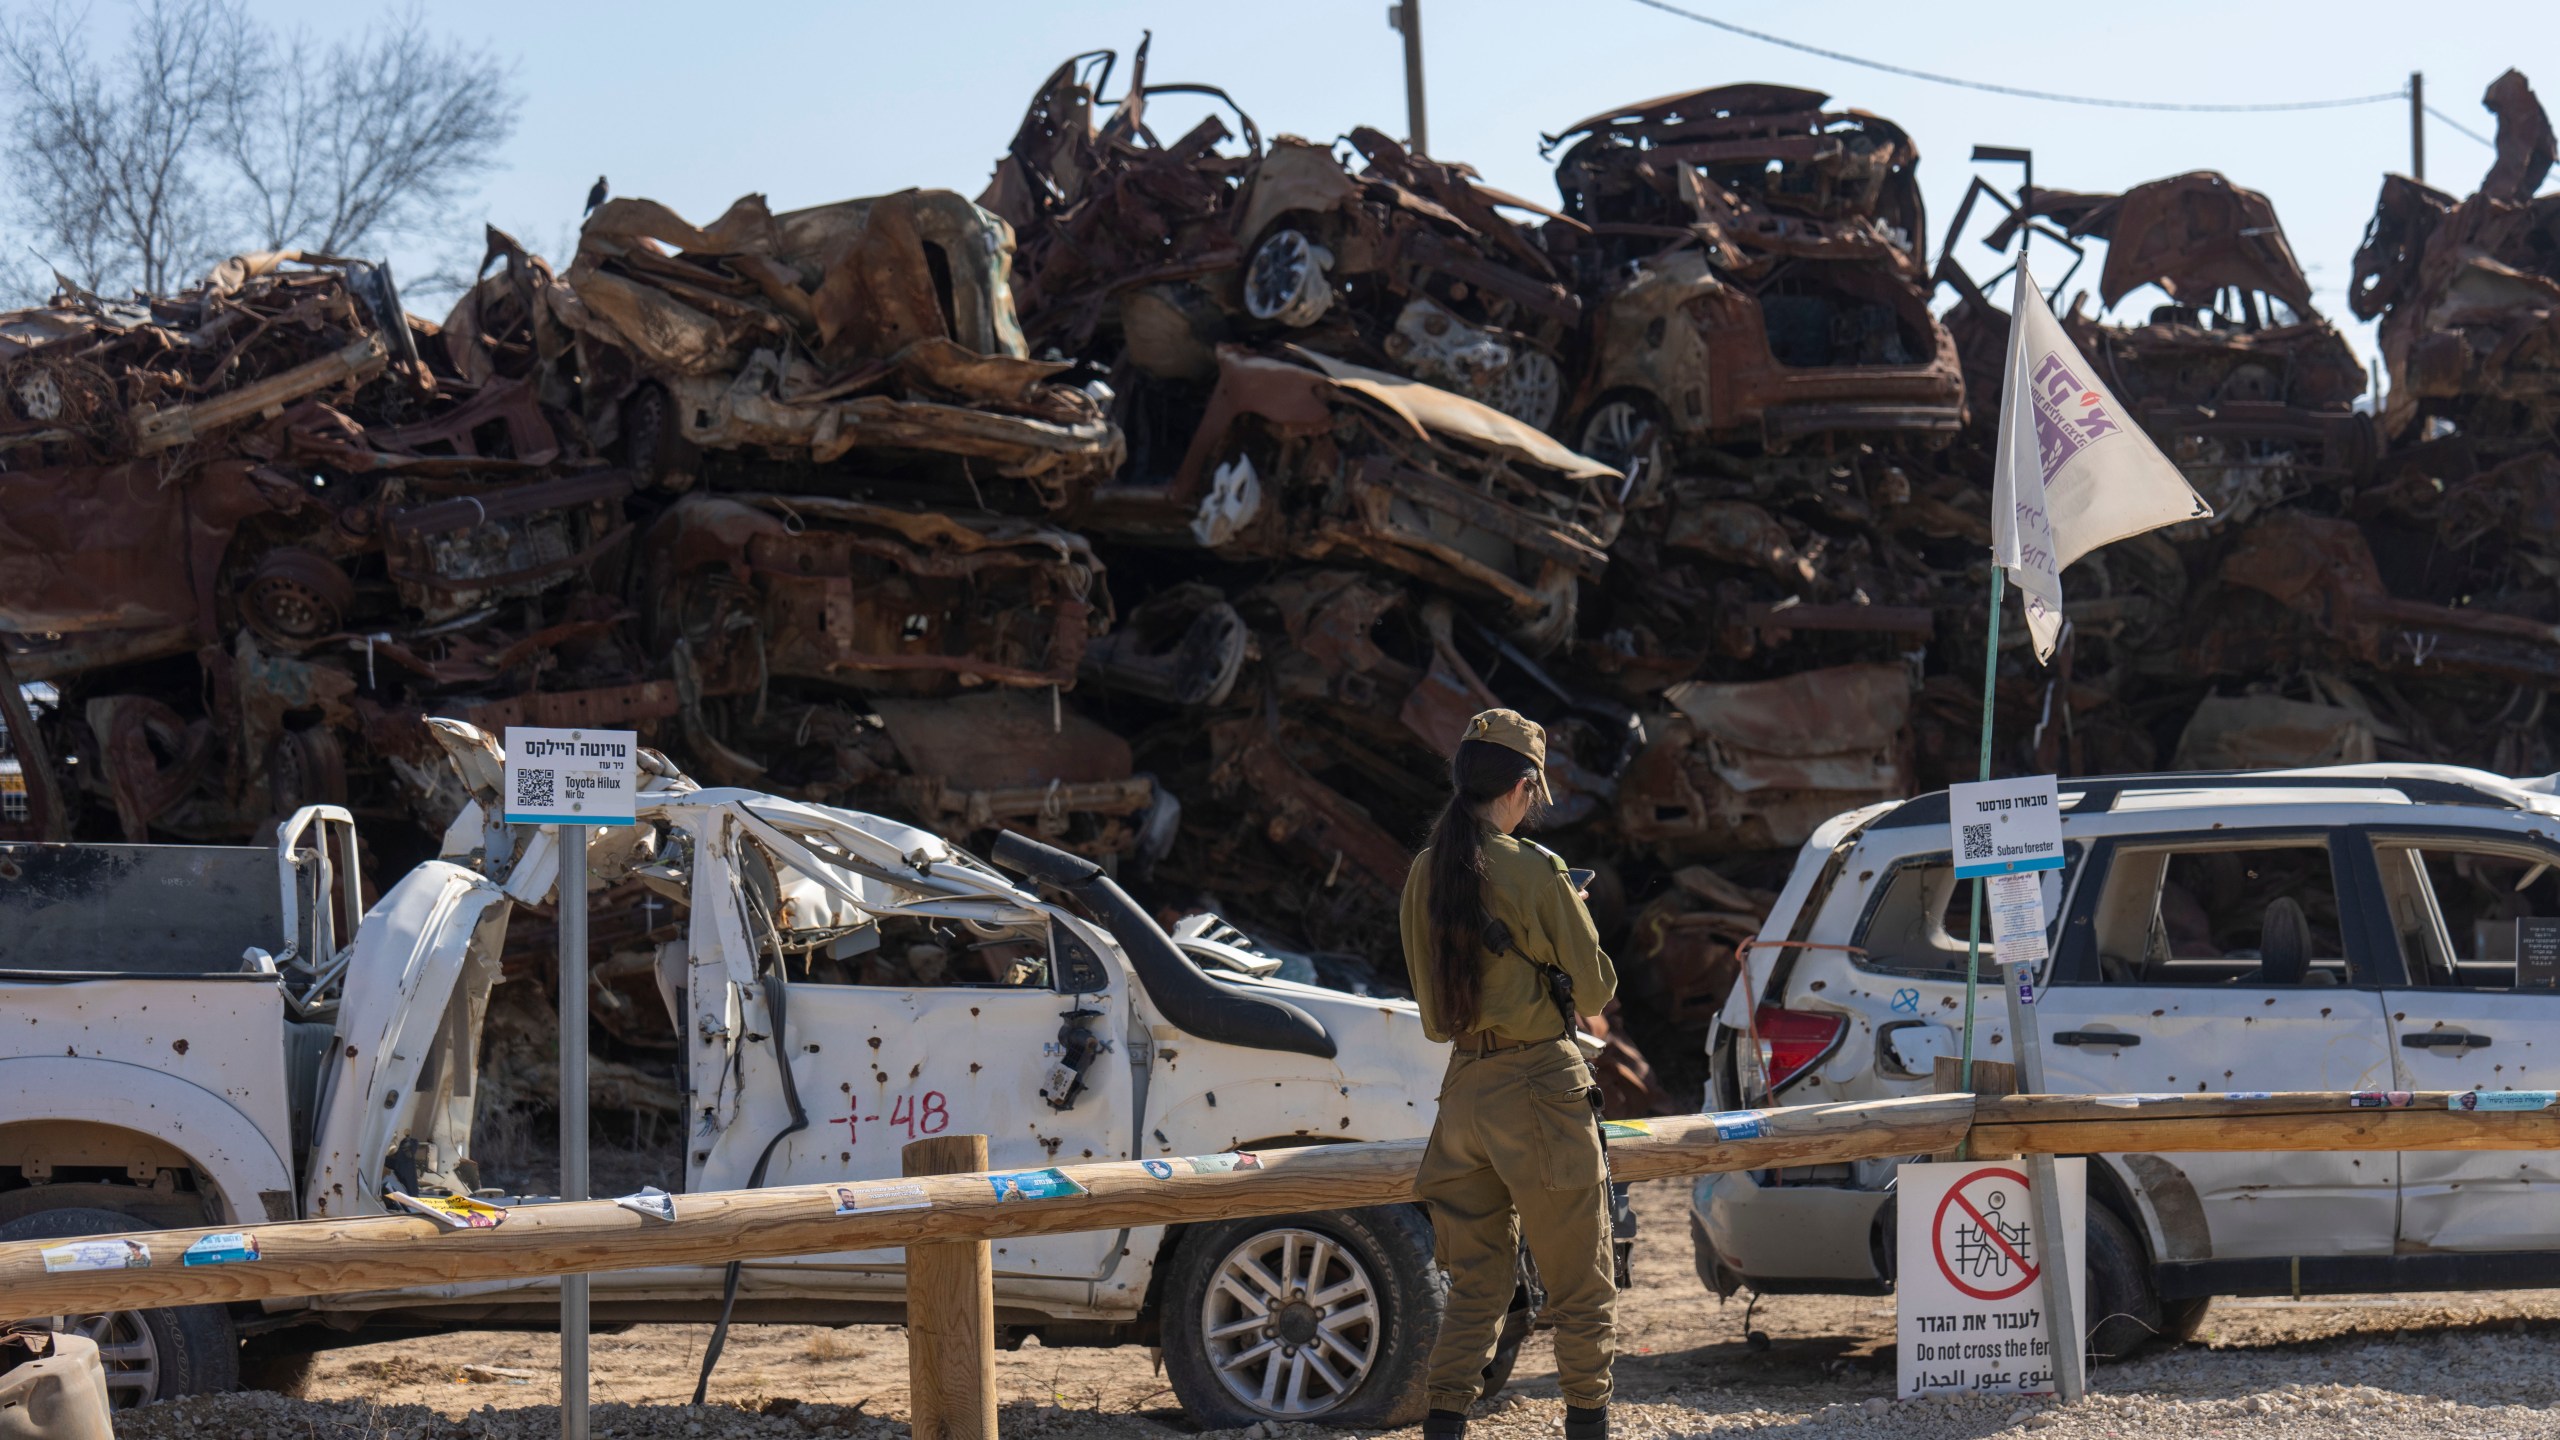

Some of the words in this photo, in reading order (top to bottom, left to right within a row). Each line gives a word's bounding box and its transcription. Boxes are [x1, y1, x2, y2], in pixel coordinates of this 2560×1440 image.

[525, 739, 575, 758] היילקס
[580, 742, 626, 757] טויוטה
[599, 760, 611, 769] עוז
[613, 761, 624, 770] ניר
[565, 776, 595, 791] Toyota
[597, 776, 621, 789] Hilux
[565, 790, 576, 799] Nir
[576, 791, 585, 799] Oz
[2015, 794, 2048, 809] סובארו
[1976, 798, 2011, 812] פורסטר
[1997, 843, 2024, 857] Subaru
[2024, 841, 2054, 854] forester
[1916, 1315, 1957, 1333] הגדר
[1962, 1313, 1986, 1331] את
[1992, 1309, 2040, 1330] לעבור
[1917, 1342, 1934, 1361] Do
[1938, 1341, 1961, 1360] not
[1964, 1342, 2002, 1359] cross
[2004, 1338, 2027, 1357] the
[1912, 1369, 1965, 1393] الجدار
[1971, 1370, 2012, 1390] عبور
